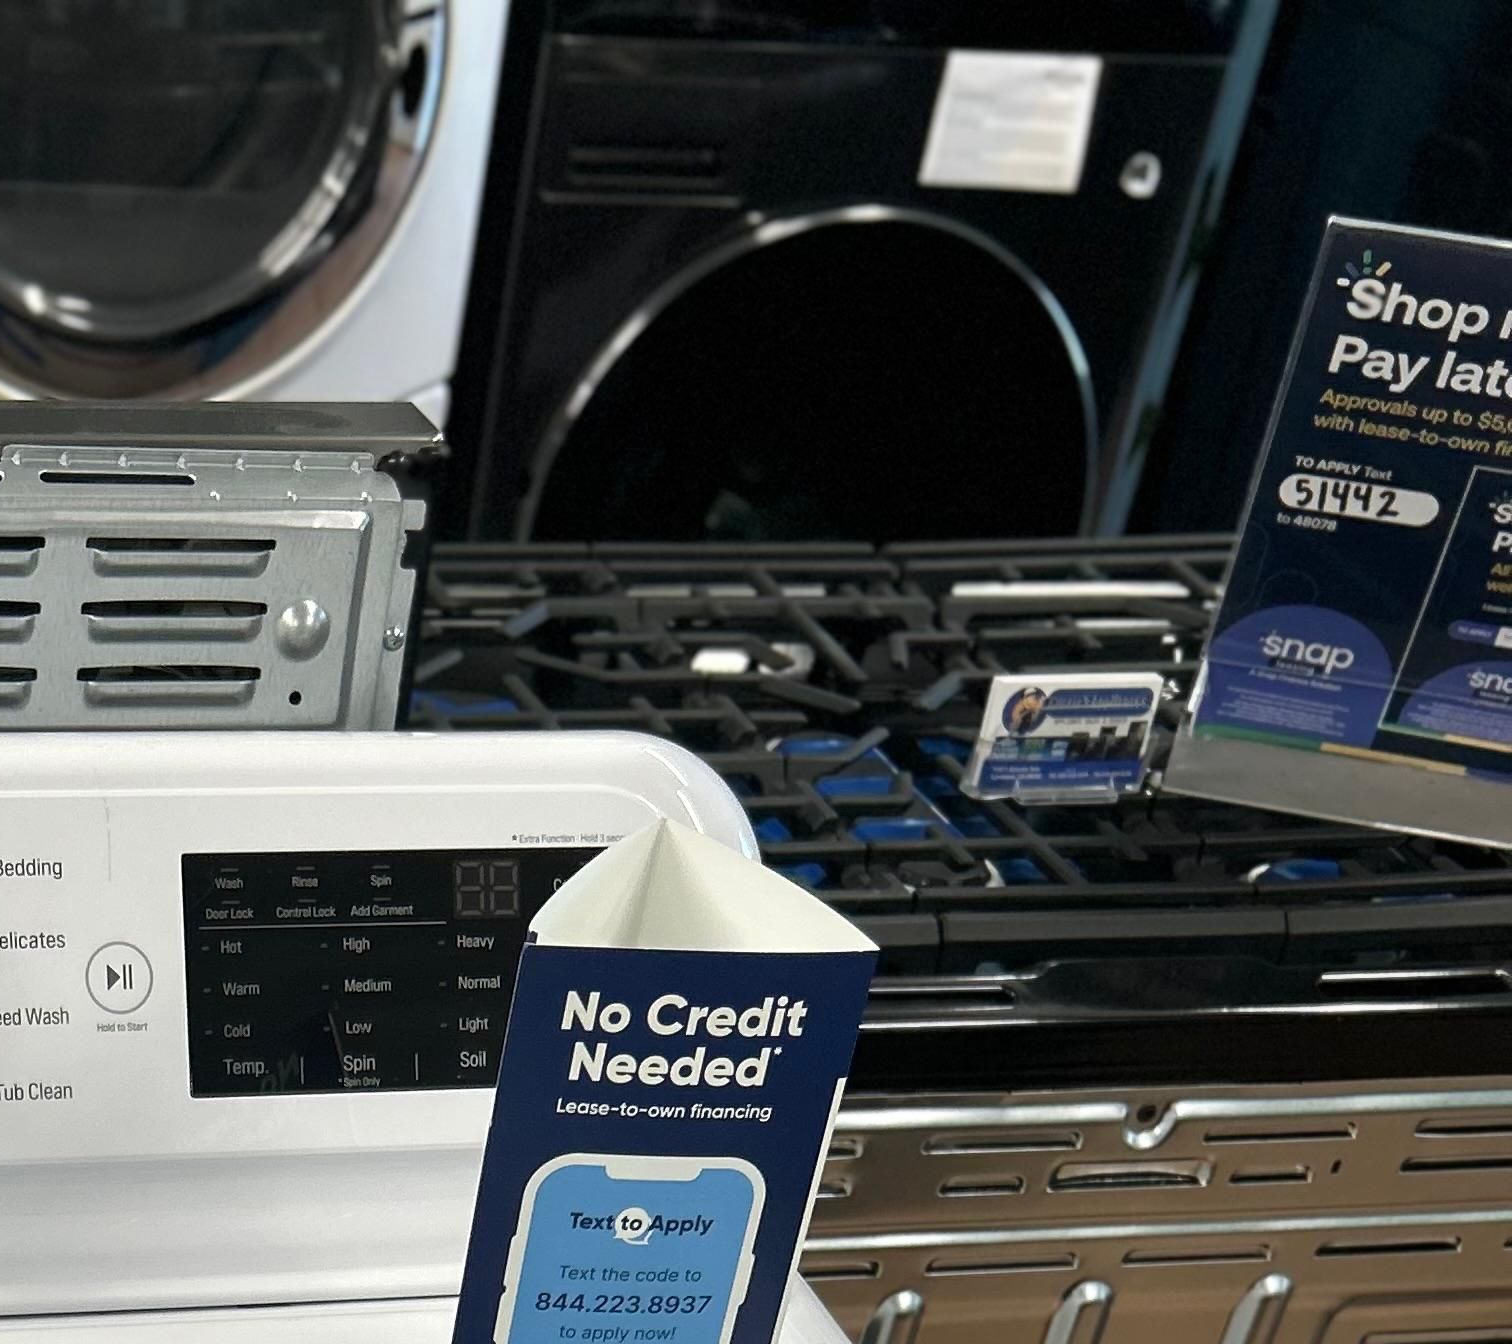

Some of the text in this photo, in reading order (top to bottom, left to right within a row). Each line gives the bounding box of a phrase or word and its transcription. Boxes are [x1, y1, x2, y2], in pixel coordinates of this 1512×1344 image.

[1346, 278, 1489, 342] Shop
[1328, 334, 1512, 399] Pay lat
[1320, 388, 1417, 418] Approvals
[1421, 408, 1448, 426] up
[1453, 409, 1473, 427] to
[1313, 413, 1354, 433] with
[1358, 418, 1490, 453] lease-to-own
[1295, 455, 1392, 481] TO APPLY Text
[1295, 479, 1400, 519] 51442
[1276, 512, 1337, 531] to 48078
[1262, 633, 1355, 674] snap
[214, 877, 244, 890] Wash
[291, 875, 319, 889] Rinse
[369, 874, 393, 889] Spin
[205, 907, 254, 920] Door Lock
[276, 905, 336, 919] Control Lock
[350, 903, 414, 918] Add Garment
[220, 940, 243, 955] Hot
[343, 937, 371, 952] High
[456, 935, 495, 952] Heavy
[222, 982, 260, 997] Warm
[344, 978, 392, 994] Medium
[457, 976, 501, 990] Normal
[25, 1007, 70, 1027] Wash
[560, 991, 808, 1037] No Credit
[96, 1021, 148, 1033] Hold to Start
[223, 1023, 251, 1038] Cold
[345, 1020, 372, 1035] Low
[458, 1017, 489, 1034] Light
[223, 1057, 270, 1078] Temp.
[342, 1054, 377, 1073] Spin
[459, 1051, 487, 1068] Soil
[26, 1081, 73, 1101] Clean
[362, 1076, 381, 1089] Only
[556, 1098, 773, 1123] Lease-to-own financing
[570, 1211, 713, 1238] Text to Apply
[559, 1265, 702, 1285] Text the code to
[535, 1291, 713, 1316] 844.223.8937
[559, 1323, 677, 1344] to apply now!
